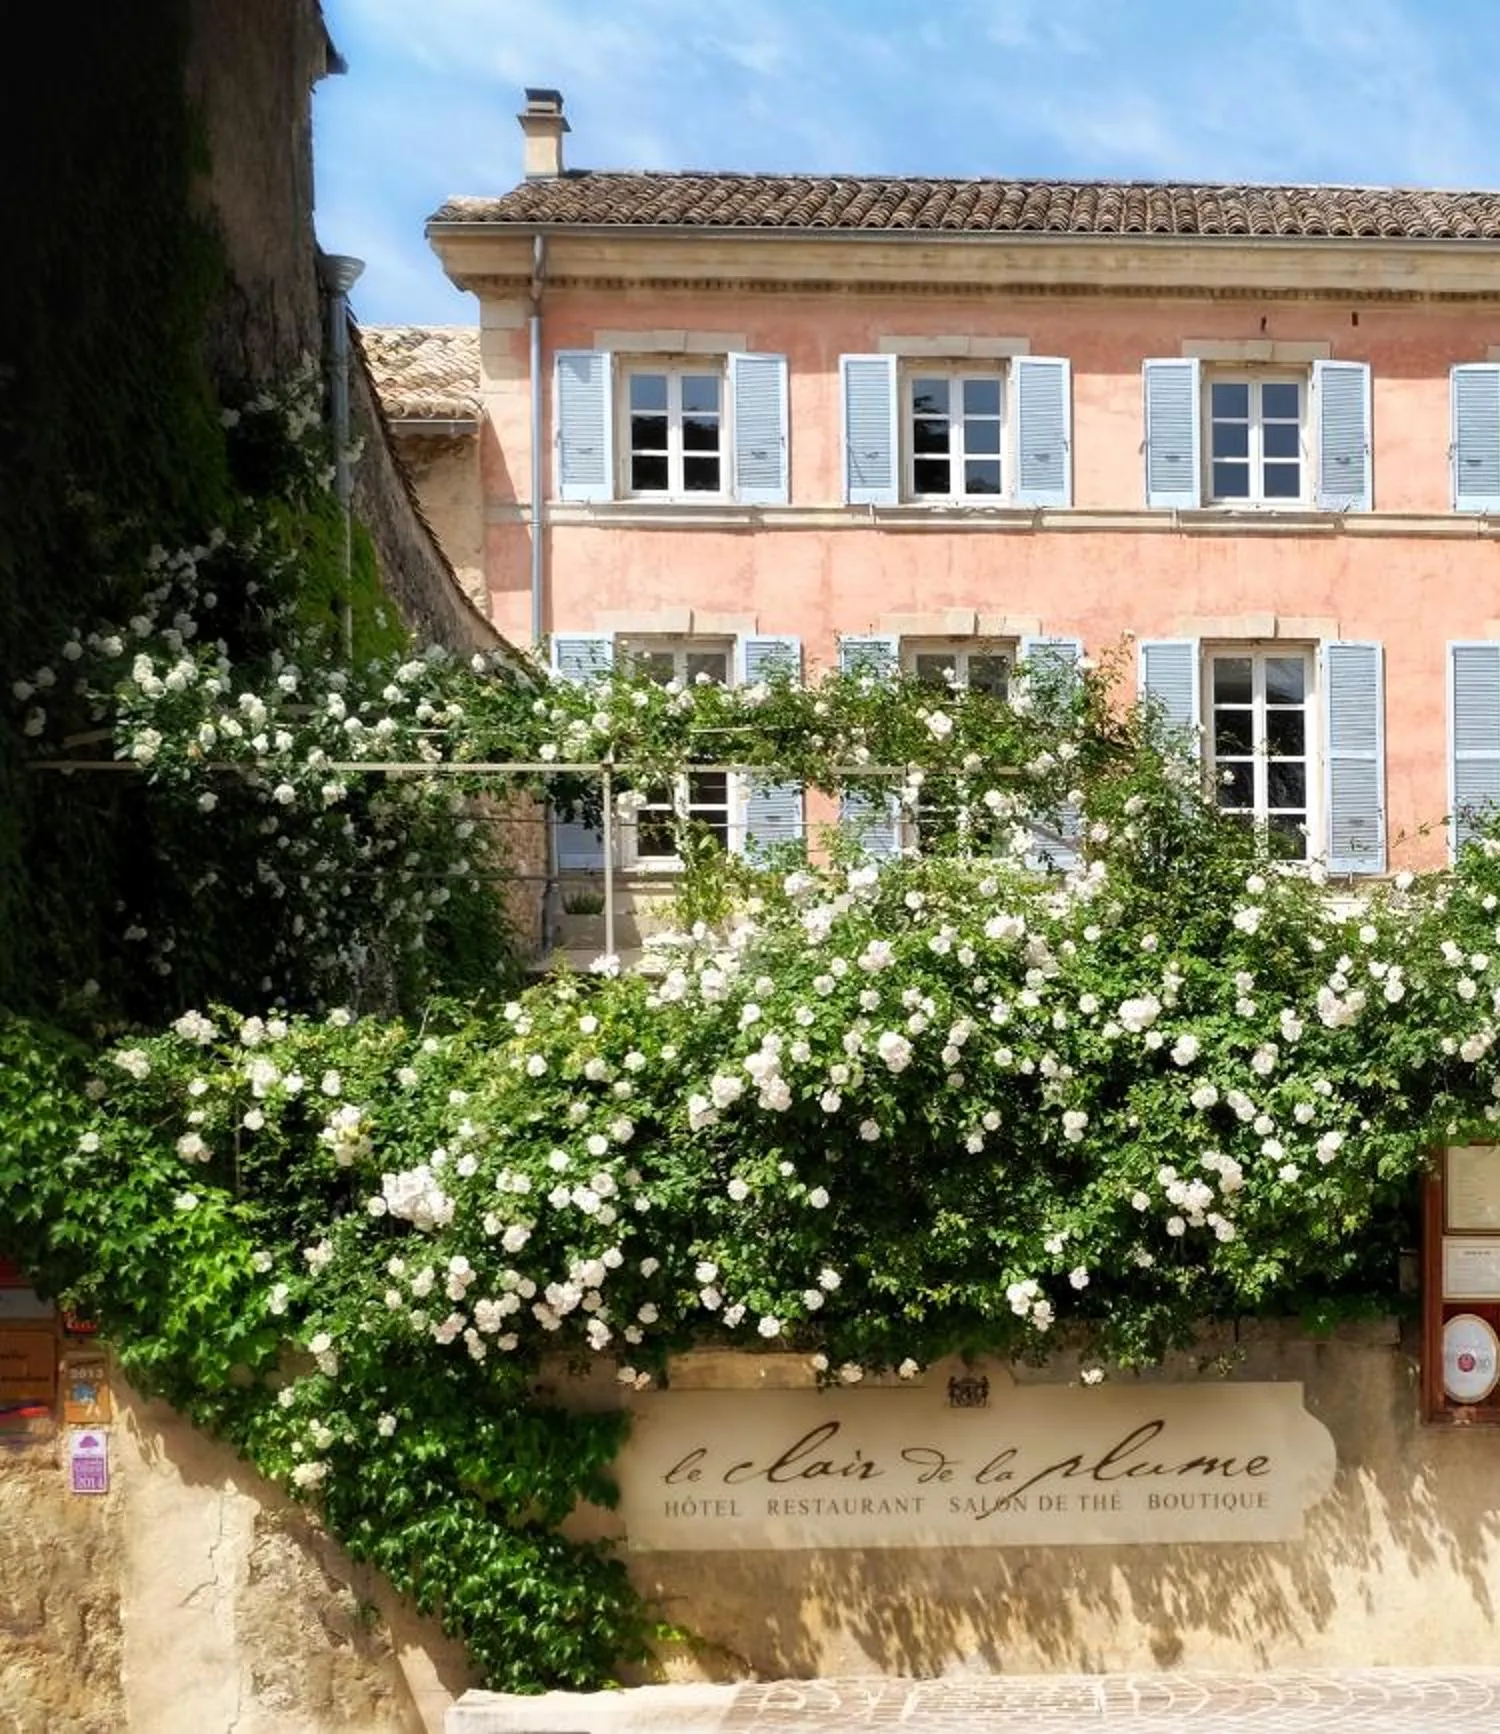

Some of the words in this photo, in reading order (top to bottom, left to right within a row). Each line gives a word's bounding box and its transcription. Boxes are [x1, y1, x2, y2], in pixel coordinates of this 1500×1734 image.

[660, 1448, 708, 1484] le
[722, 1420, 885, 1483] clair
[900, 1447, 956, 1483] de
[975, 1448, 1018, 1484] la
[975, 1419, 1273, 1520] plume
[664, 1496, 742, 1518] HÔTEL
[766, 1496, 925, 1517] RESTAURANT
[949, 1493, 1028, 1514] SALON
[1038, 1492, 1069, 1512] DE
[1080, 1490, 1122, 1512] THÉ
[1148, 1491, 1272, 1513] BOUTIQUE
